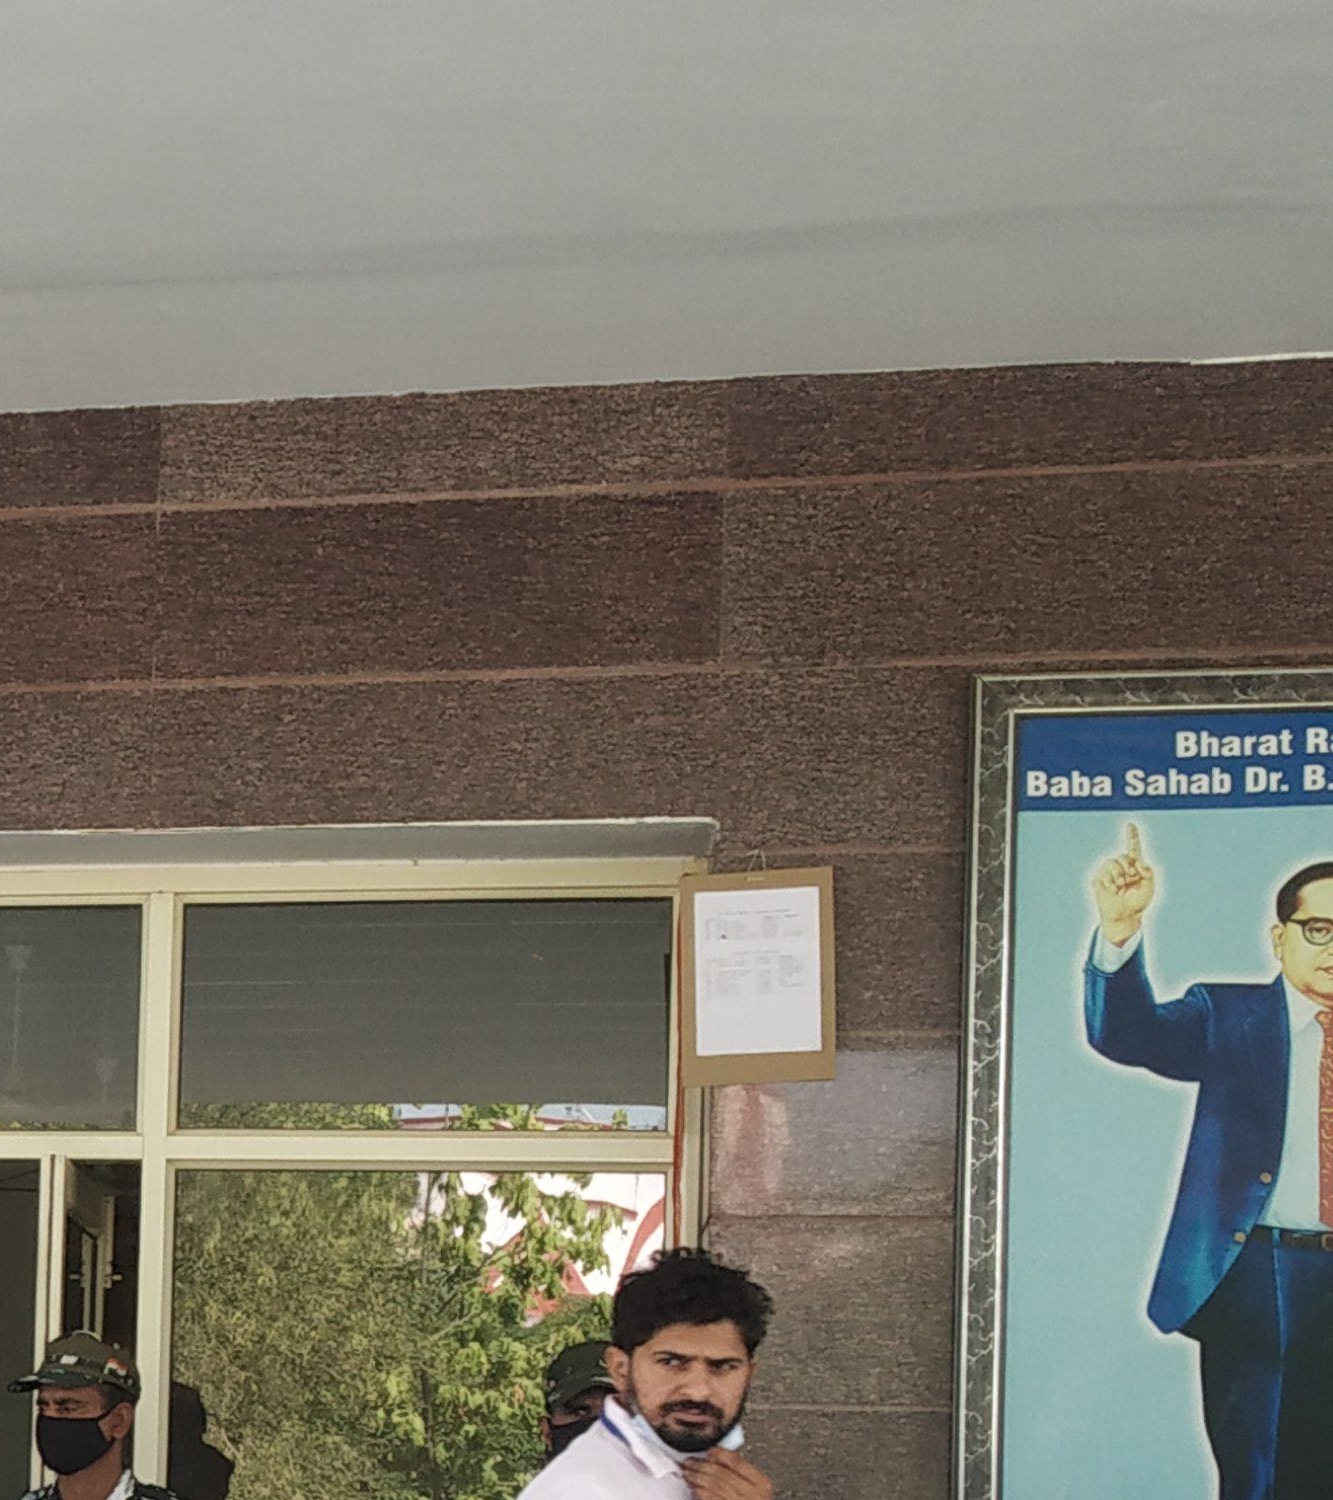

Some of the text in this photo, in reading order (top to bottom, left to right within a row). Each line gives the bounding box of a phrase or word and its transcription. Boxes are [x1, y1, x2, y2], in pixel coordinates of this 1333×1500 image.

[1175, 726, 1333, 758] Bharat R
[1026, 770, 1112, 797] Baba
[1125, 767, 1232, 797] Sahab
[1245, 765, 1289, 793] Dr.
